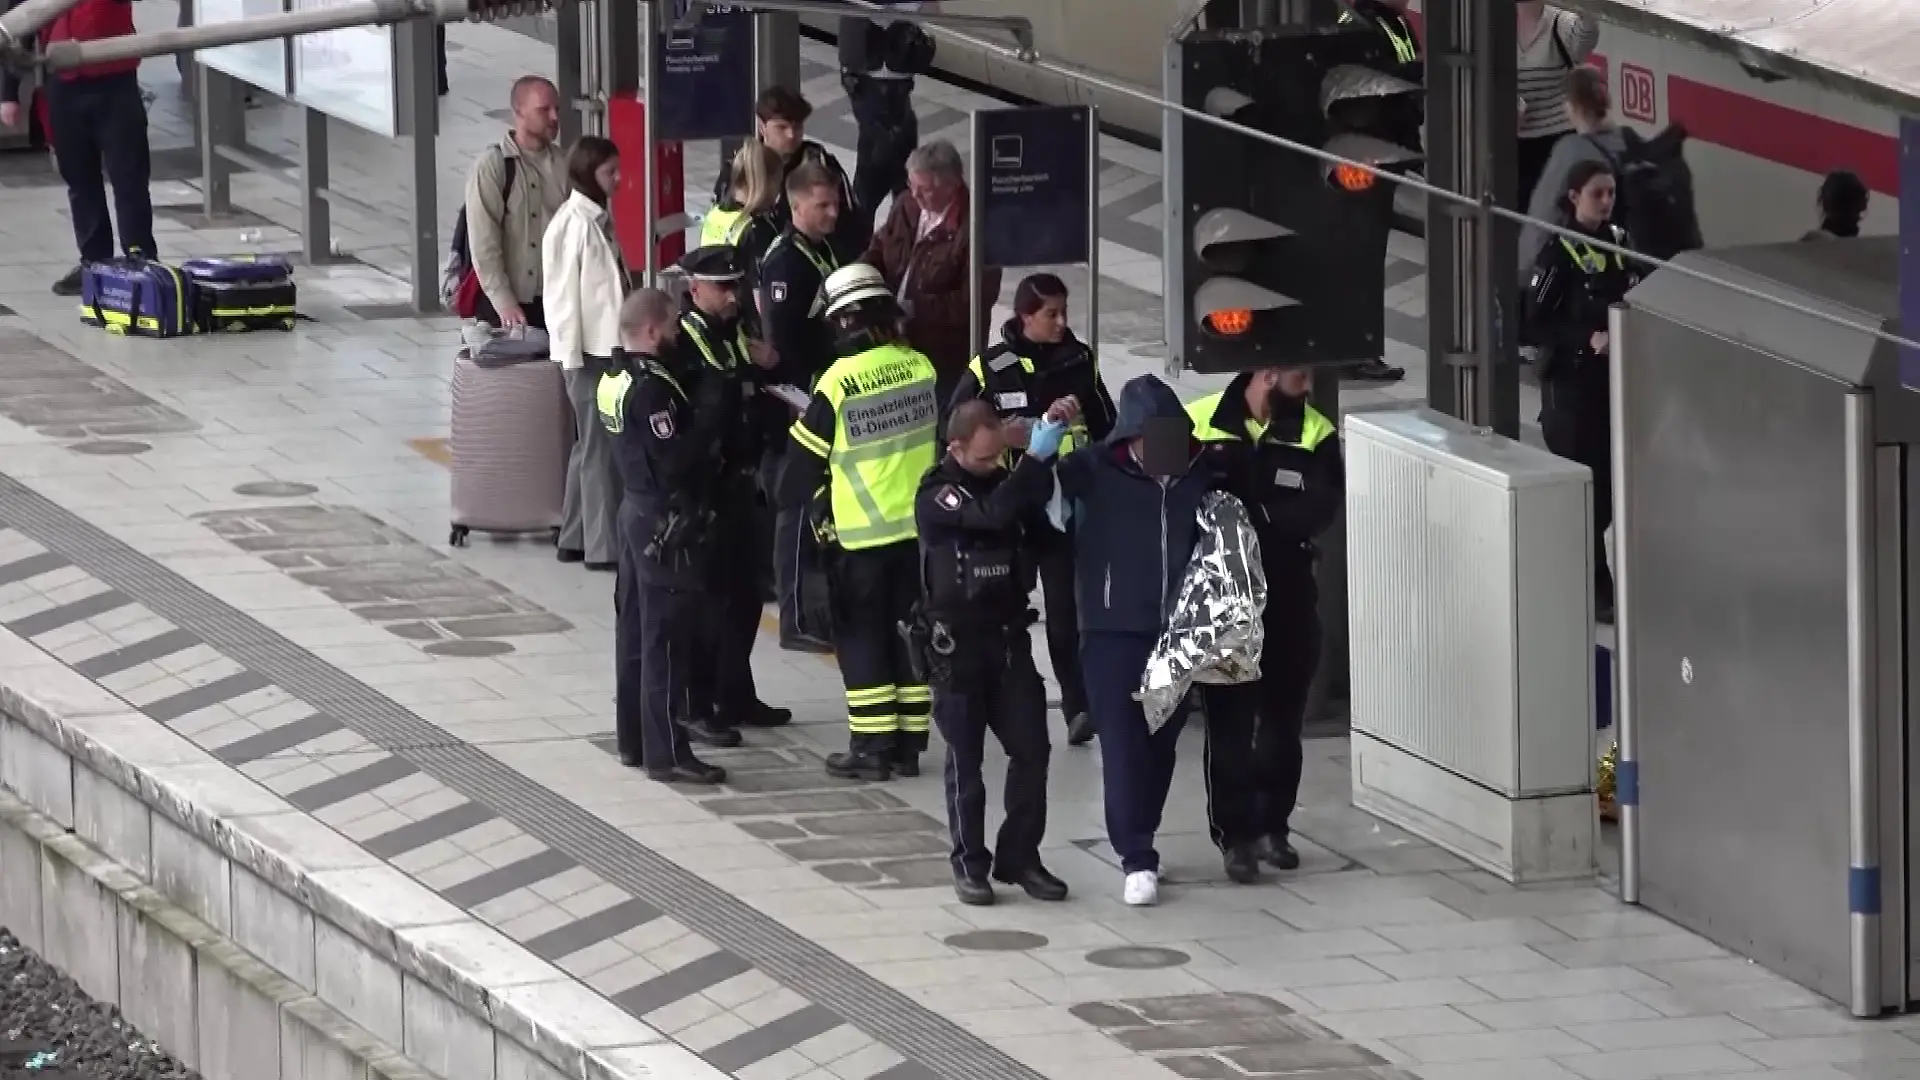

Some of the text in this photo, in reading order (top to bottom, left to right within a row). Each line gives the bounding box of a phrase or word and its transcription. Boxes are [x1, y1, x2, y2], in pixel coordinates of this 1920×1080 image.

[1624, 72, 1652, 114] DB
[857, 357, 921, 381] FEUERWEHR
[862, 369, 914, 393] HAMBURG
[850, 411, 911, 437] B-Dienst
